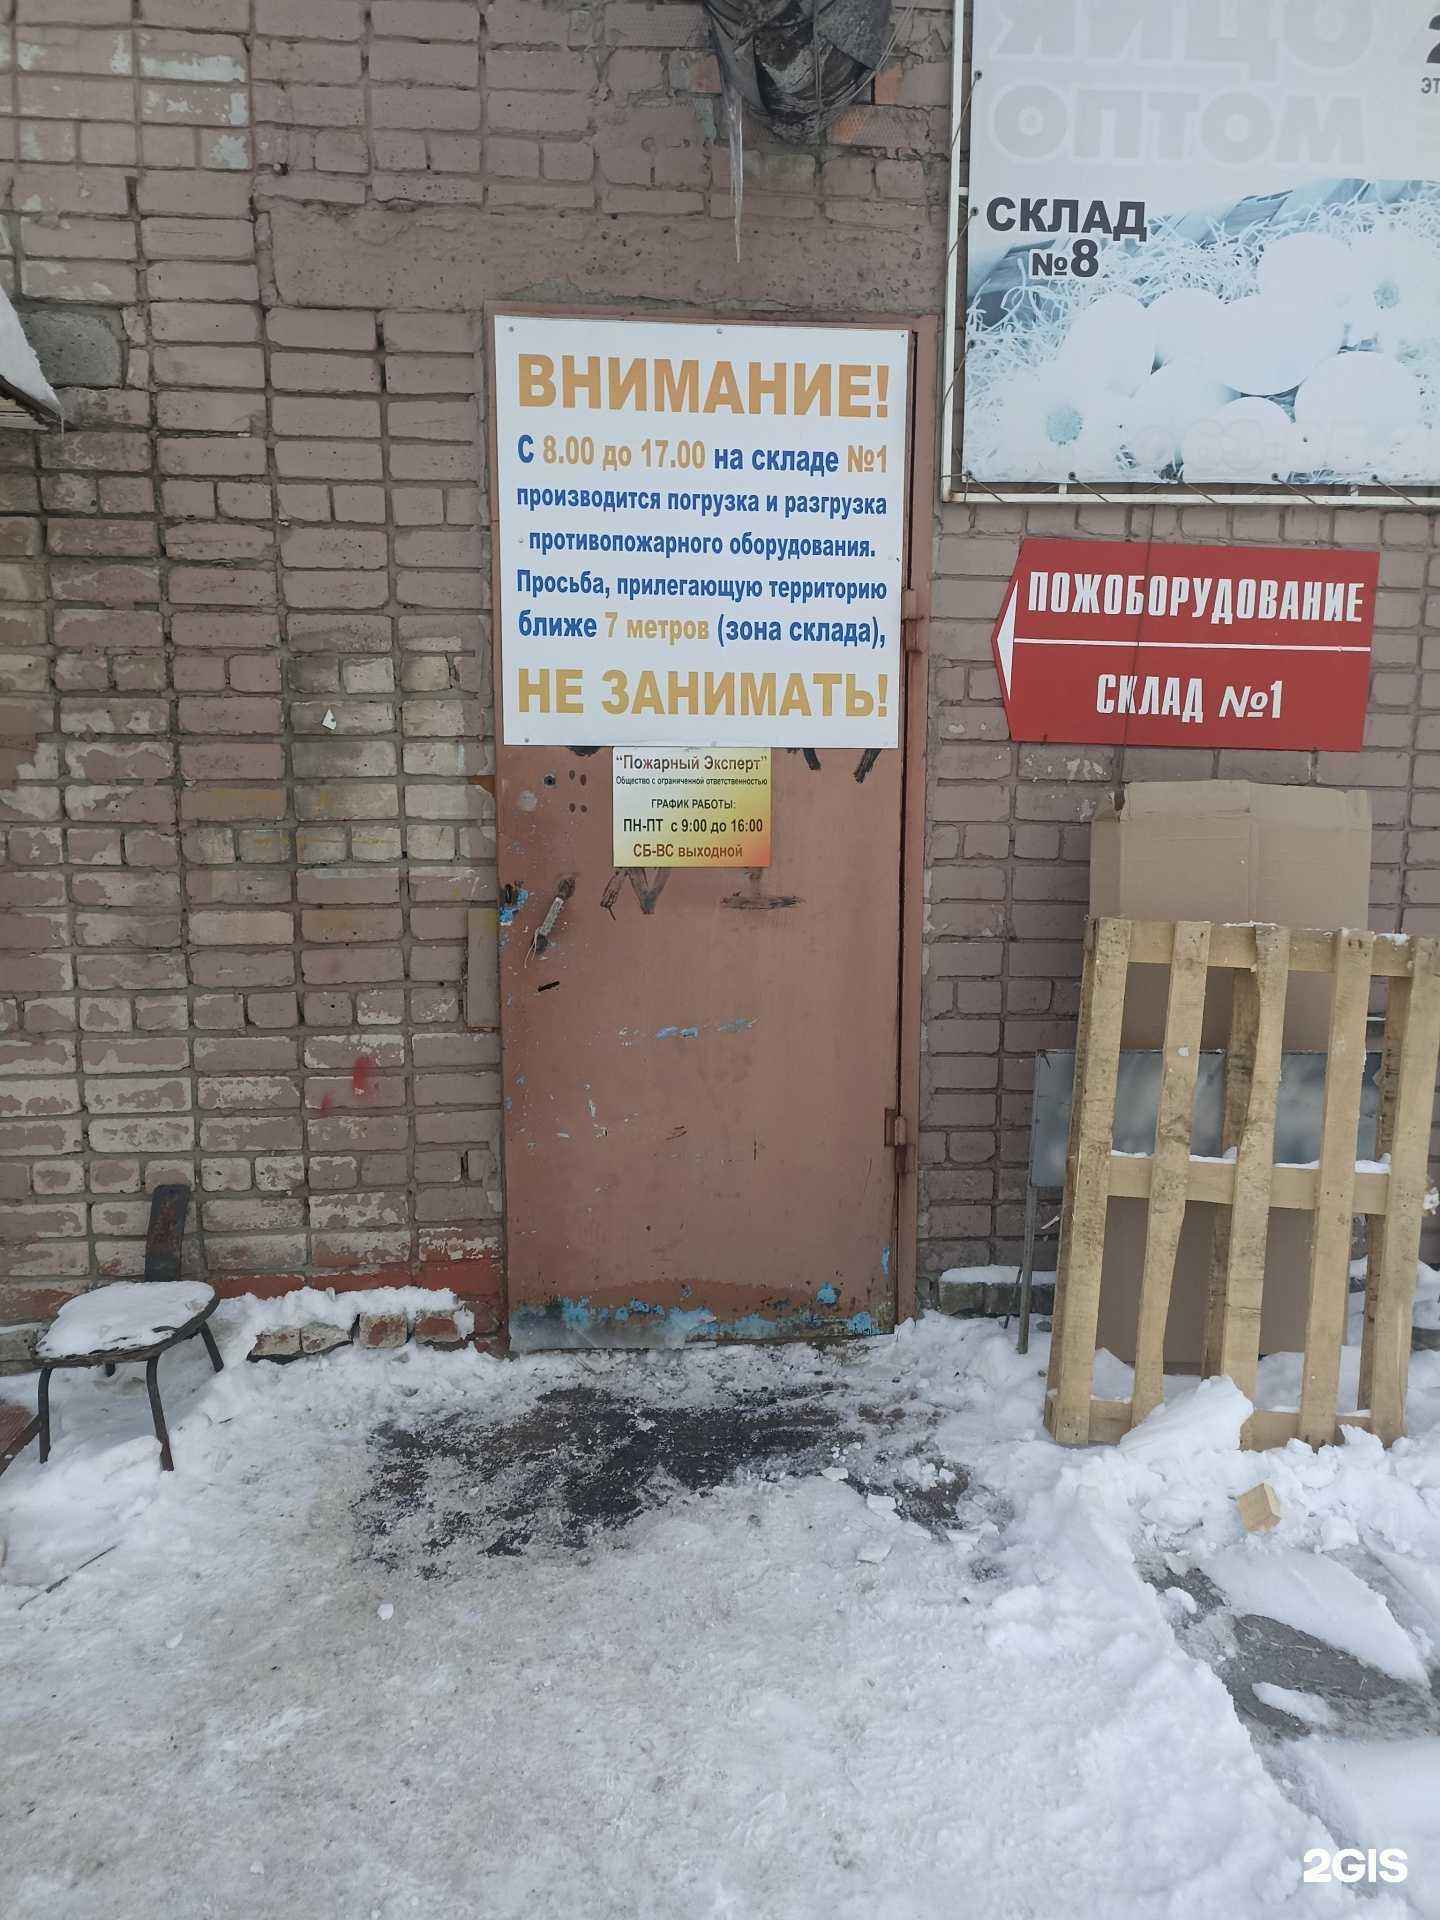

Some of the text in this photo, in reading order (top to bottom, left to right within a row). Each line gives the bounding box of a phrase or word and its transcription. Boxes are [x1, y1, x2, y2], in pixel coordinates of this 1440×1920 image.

[993, 84, 1366, 165] ОПТОМ
[986, 197, 1147, 241] СКЛАД
[1031, 240, 1099, 277] №8
[518, 353, 889, 418] ВНИМАНИЕ!
[517, 434, 888, 476] С 8.00 до 17.00 на складе №1
[517, 487, 887, 519] производится погрузка и разгрузка
[529, 531, 876, 561] противопожарного оборудования.
[517, 569, 887, 604] Просьба, прилегающую территорию
[1028, 571, 1365, 625] ПОЖОБОРУДОВАНИЕ
[518, 610, 886, 650] ближе 7 метров (зона склада),
[518, 668, 888, 717] НЕ ЗАНИМАТЬ!
[1096, 673, 1283, 723] СКЛАД №1
[616, 776, 650, 786] Общество
[657, 777, 704, 786] ограниченной
[705, 778, 768, 786] ответственностью
[651, 798, 736, 810] ГРАФИК РАБОТЫ:
[623, 818, 763, 834] ПН-ПТ с 9:00 до 16:00
[633, 843, 743, 859] СБ-ВС выходной
